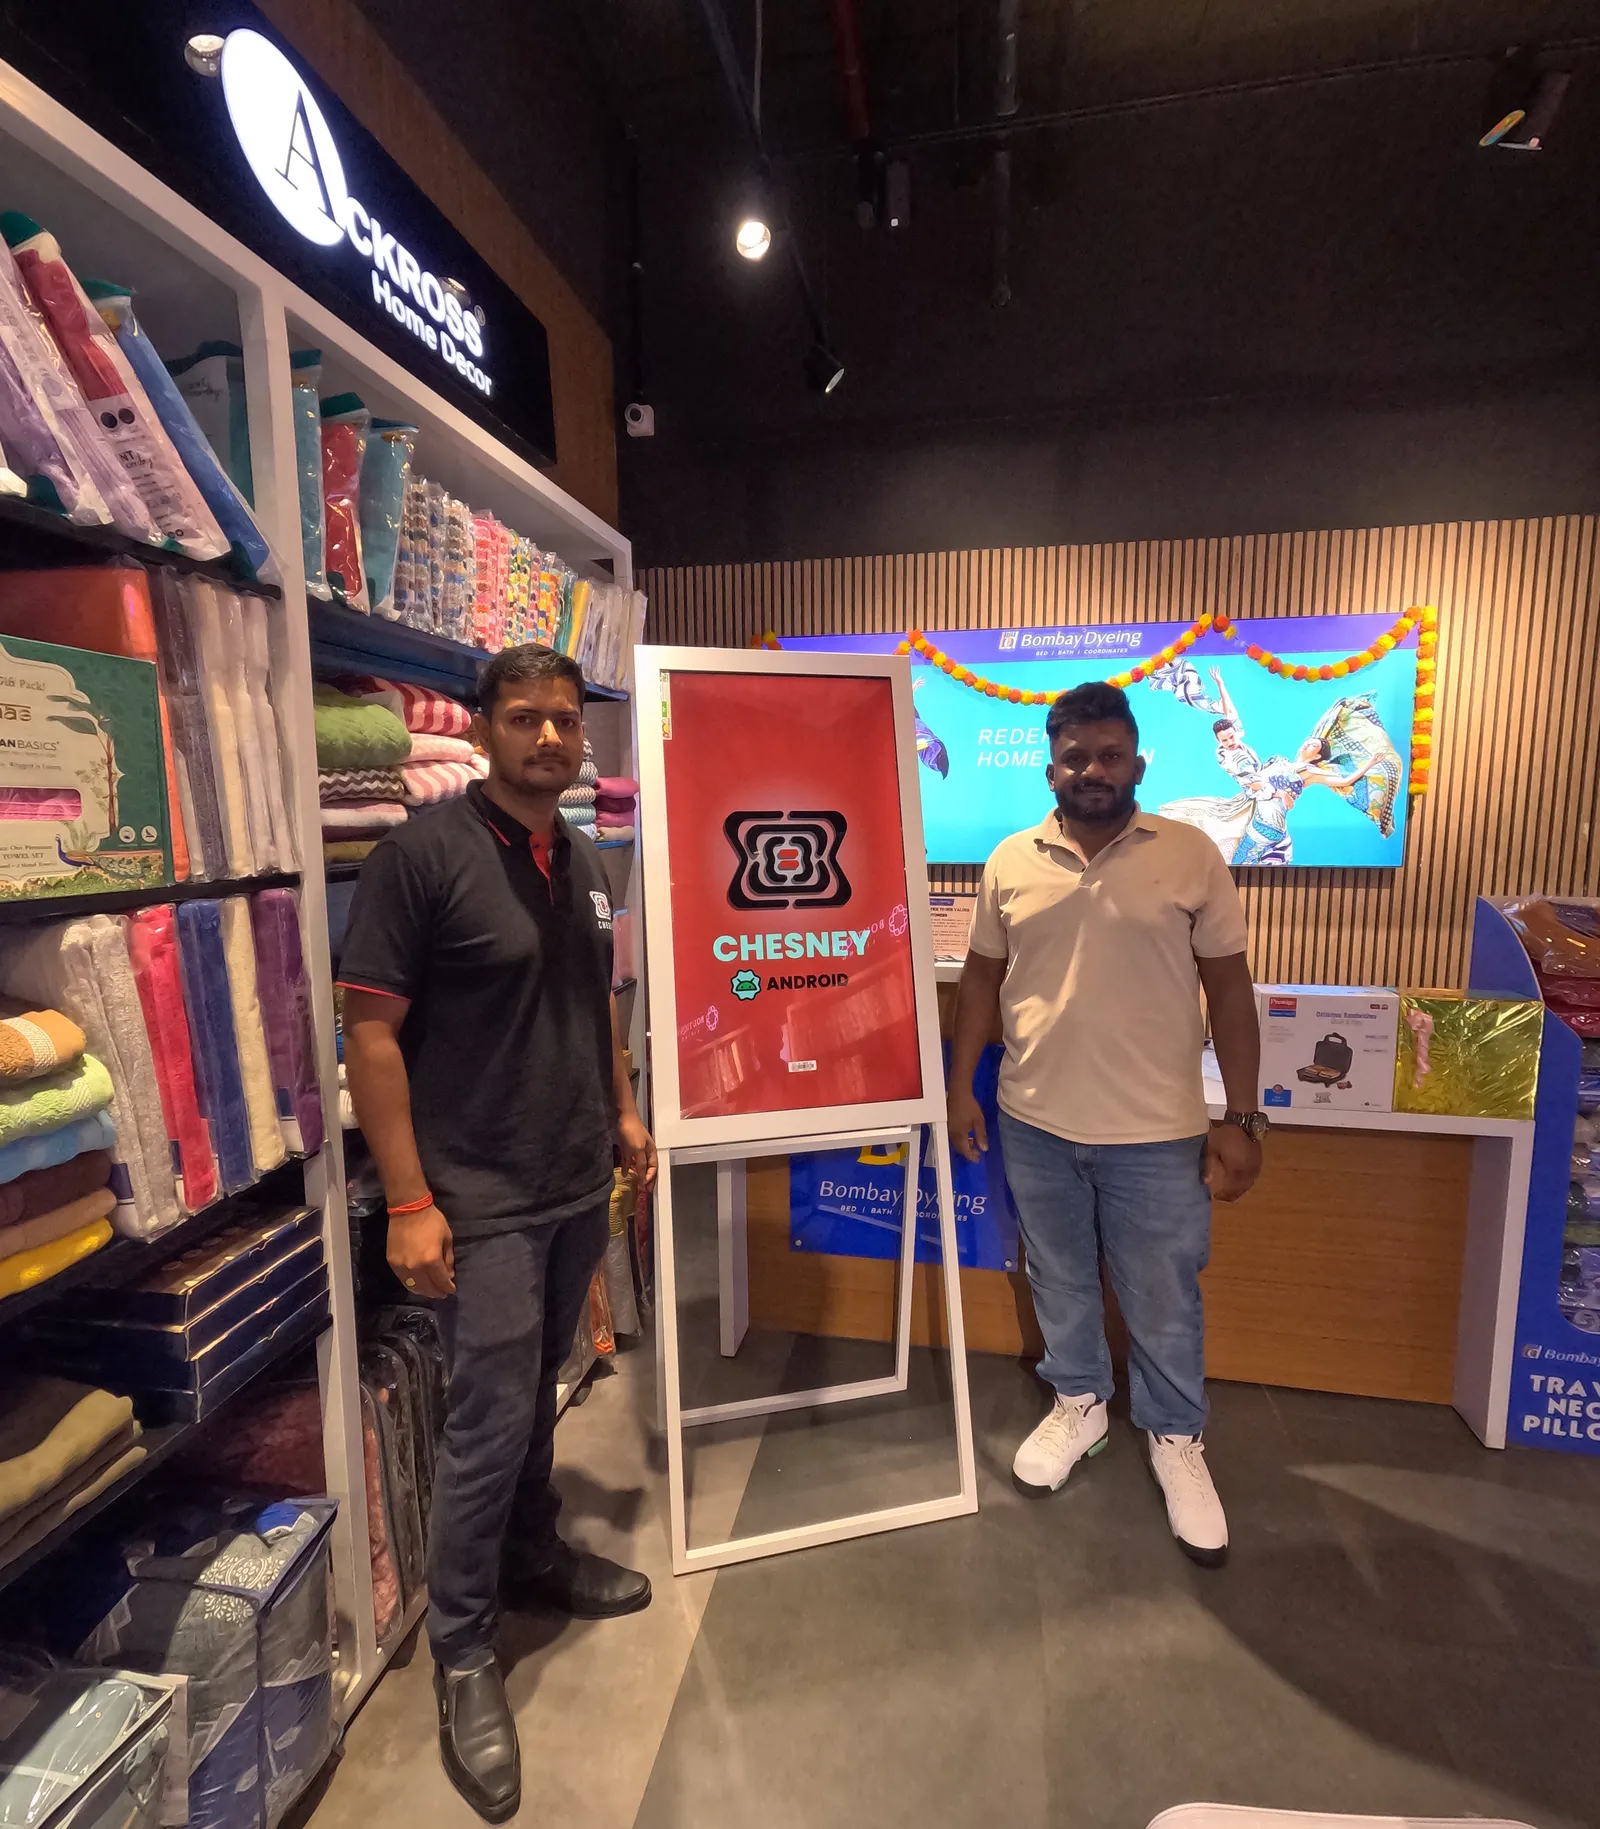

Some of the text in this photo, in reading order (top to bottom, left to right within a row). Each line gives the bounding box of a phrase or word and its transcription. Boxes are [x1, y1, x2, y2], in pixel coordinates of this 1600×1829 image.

[371, 269, 493, 396] Home Decor
[1021, 632, 1083, 648] Bombay
[1084, 630, 1142, 647] Dyeing
[977, 749, 1045, 767] HOME
[713, 929, 871, 962] CHESNEY
[766, 973, 849, 991] ANDROID
[819, 1180, 903, 1207] Bombay
[840, 1205, 857, 1213] BED
[870, 1207, 893, 1215] BATH
